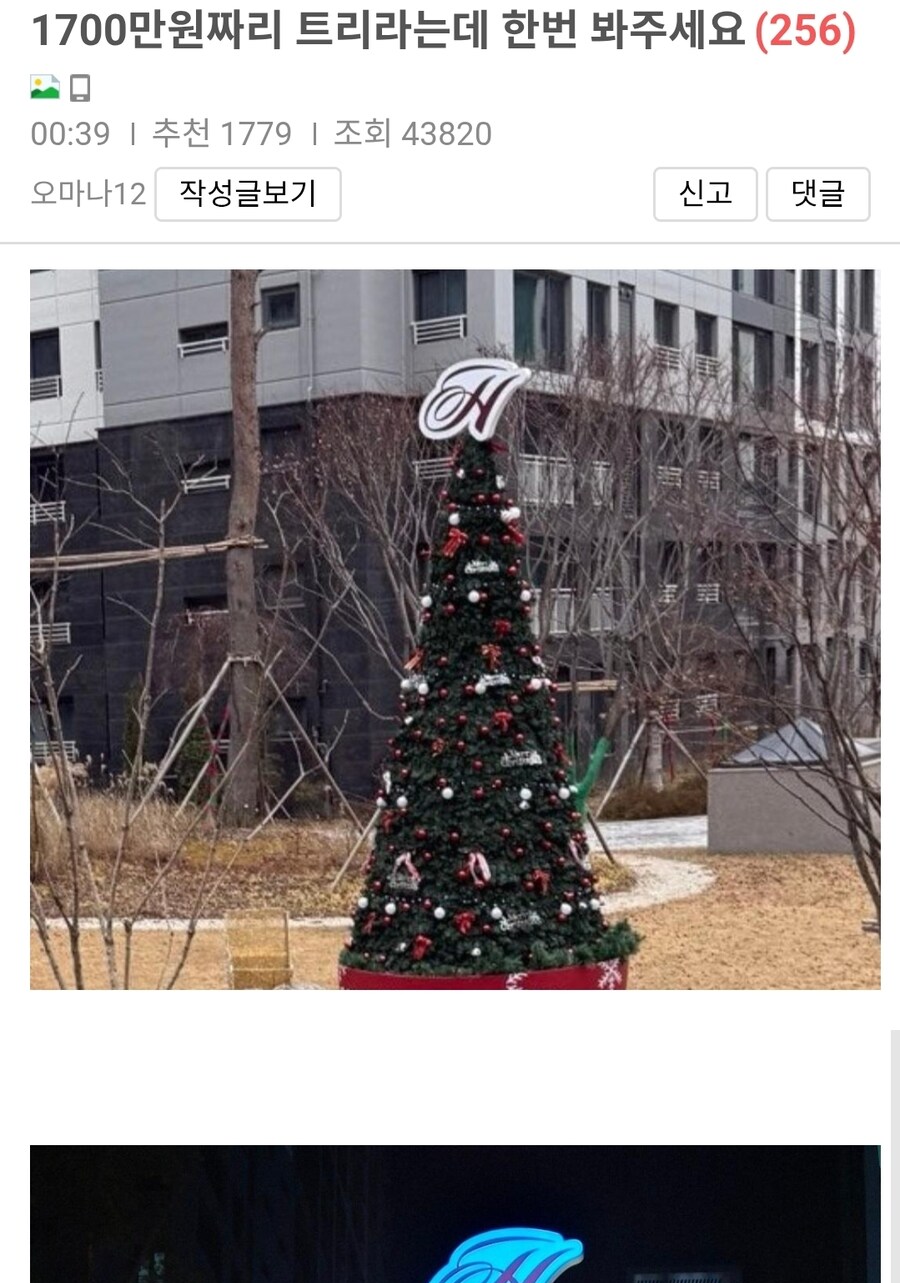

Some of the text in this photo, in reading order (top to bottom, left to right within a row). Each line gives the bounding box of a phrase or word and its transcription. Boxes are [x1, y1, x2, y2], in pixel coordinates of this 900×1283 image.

[32, 8, 856, 55] 1700만원짜리 트리라는데 한번 봐주세요 (256)
[31, 117, 492, 148] 00:39 추천 1779 조회 43820
[31, 178, 146, 208] 오마나12
[180, 178, 315, 208] 작성글보기
[679, 178, 733, 207] 신고
[792, 178, 845, 208] 댓글
